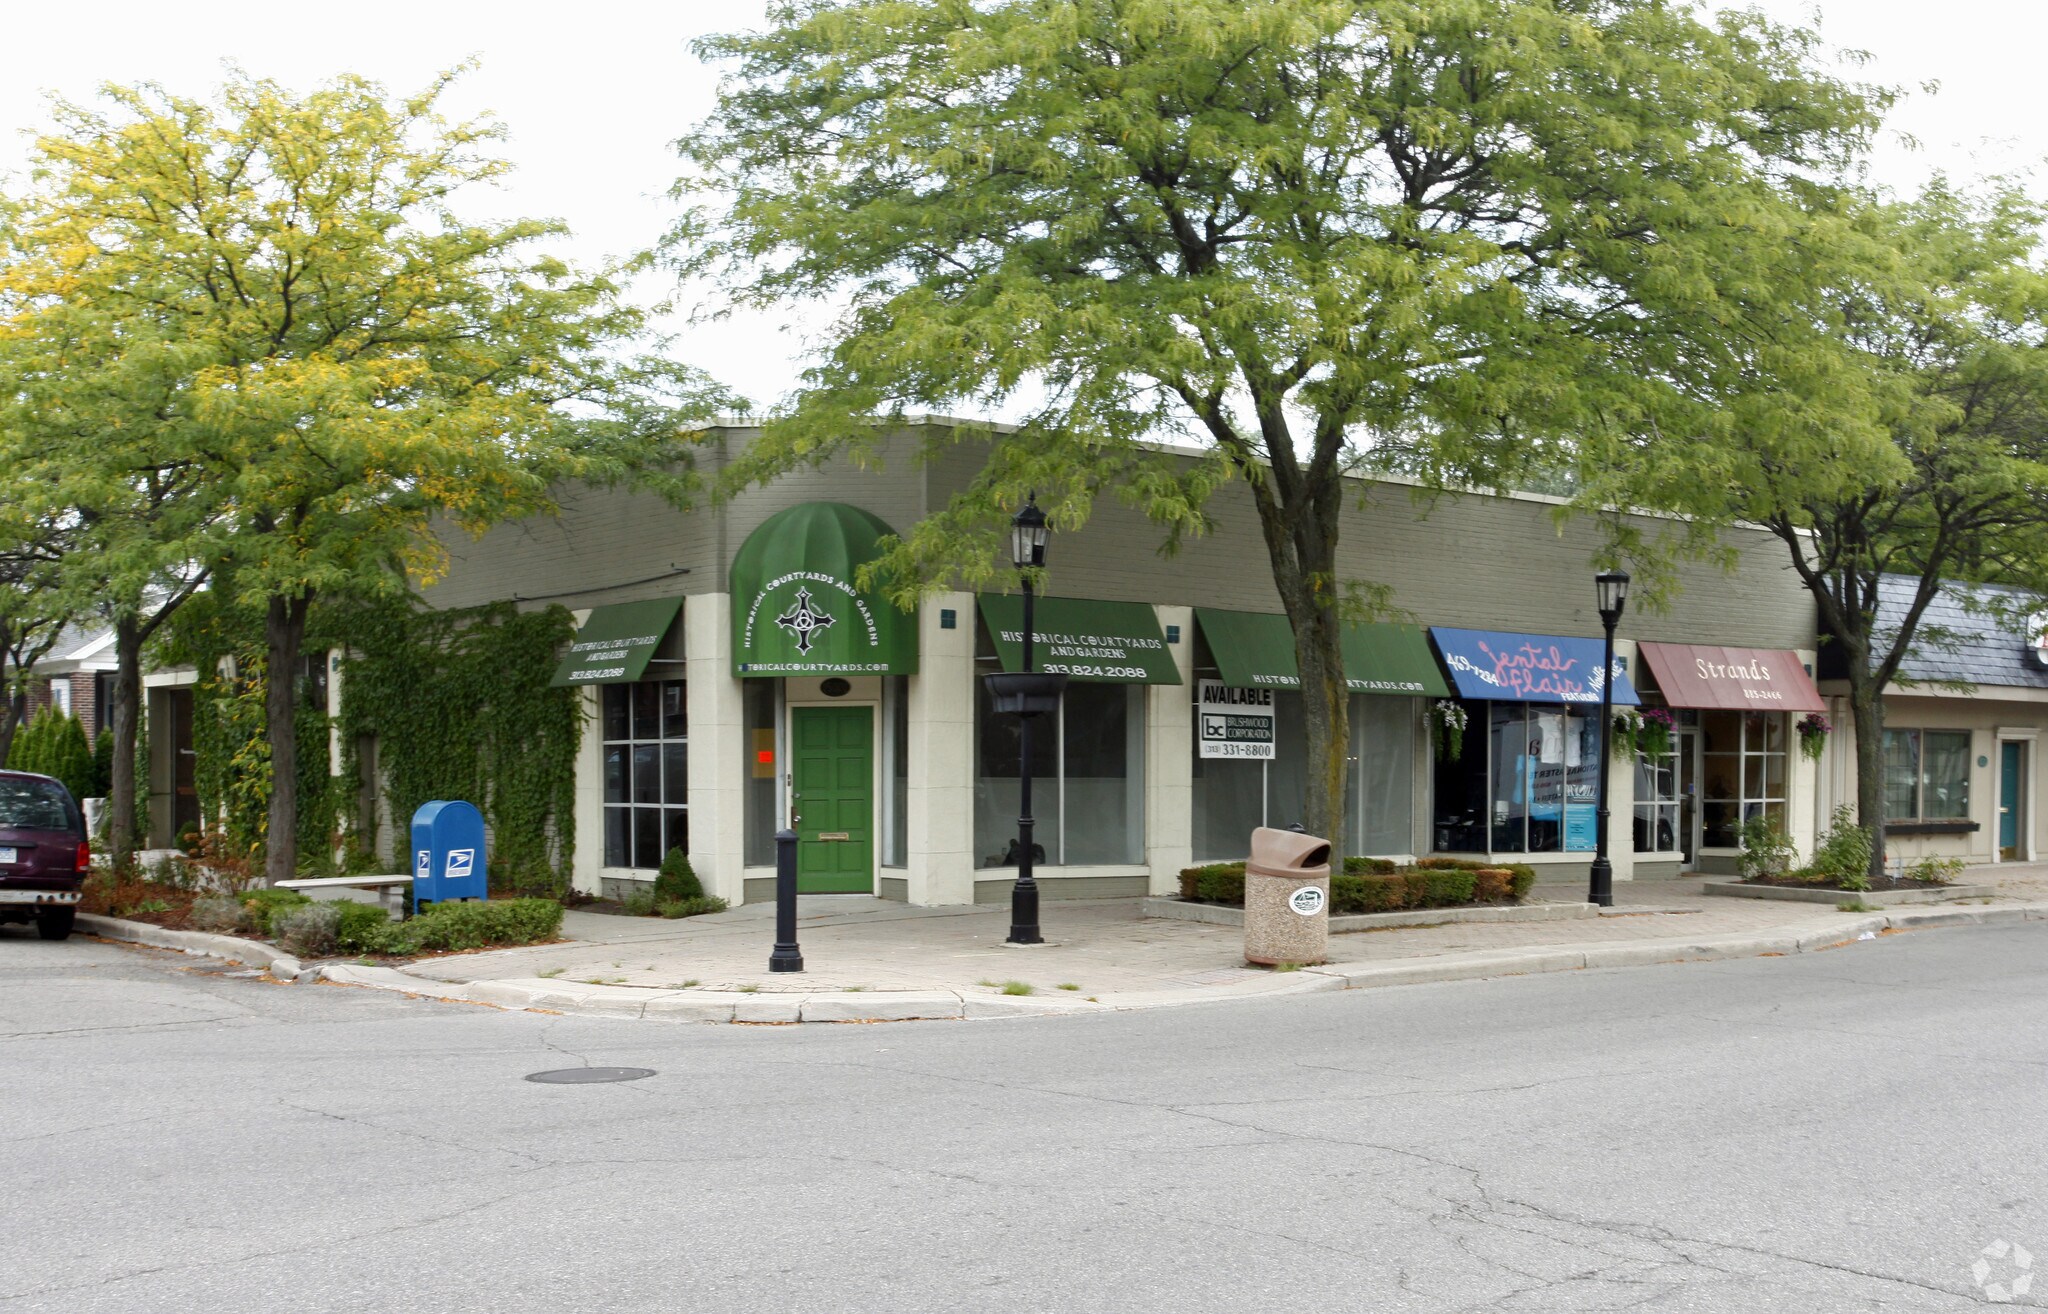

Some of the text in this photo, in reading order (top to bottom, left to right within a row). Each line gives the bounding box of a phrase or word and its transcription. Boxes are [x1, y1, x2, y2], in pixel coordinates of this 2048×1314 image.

[744, 571, 879, 648] HISTORICAL COURTYARDS AND GARDENS
[1000, 631, 1162, 650] HISORICAL COURTYARDS
[1050, 646, 1127, 659] AND GARDENS
[568, 667, 625, 680] 313.824.2088
[1043, 663, 1147, 678] 313.824.2088
[1696, 658, 1771, 681] Strands
[1203, 685, 1271, 706] AVAILABLE
[1228, 716, 1269, 728] BRUSHWOOD
[1228, 728, 1272, 739] CORPORATION
[1205, 743, 1271, 757] (313) 331-8800
